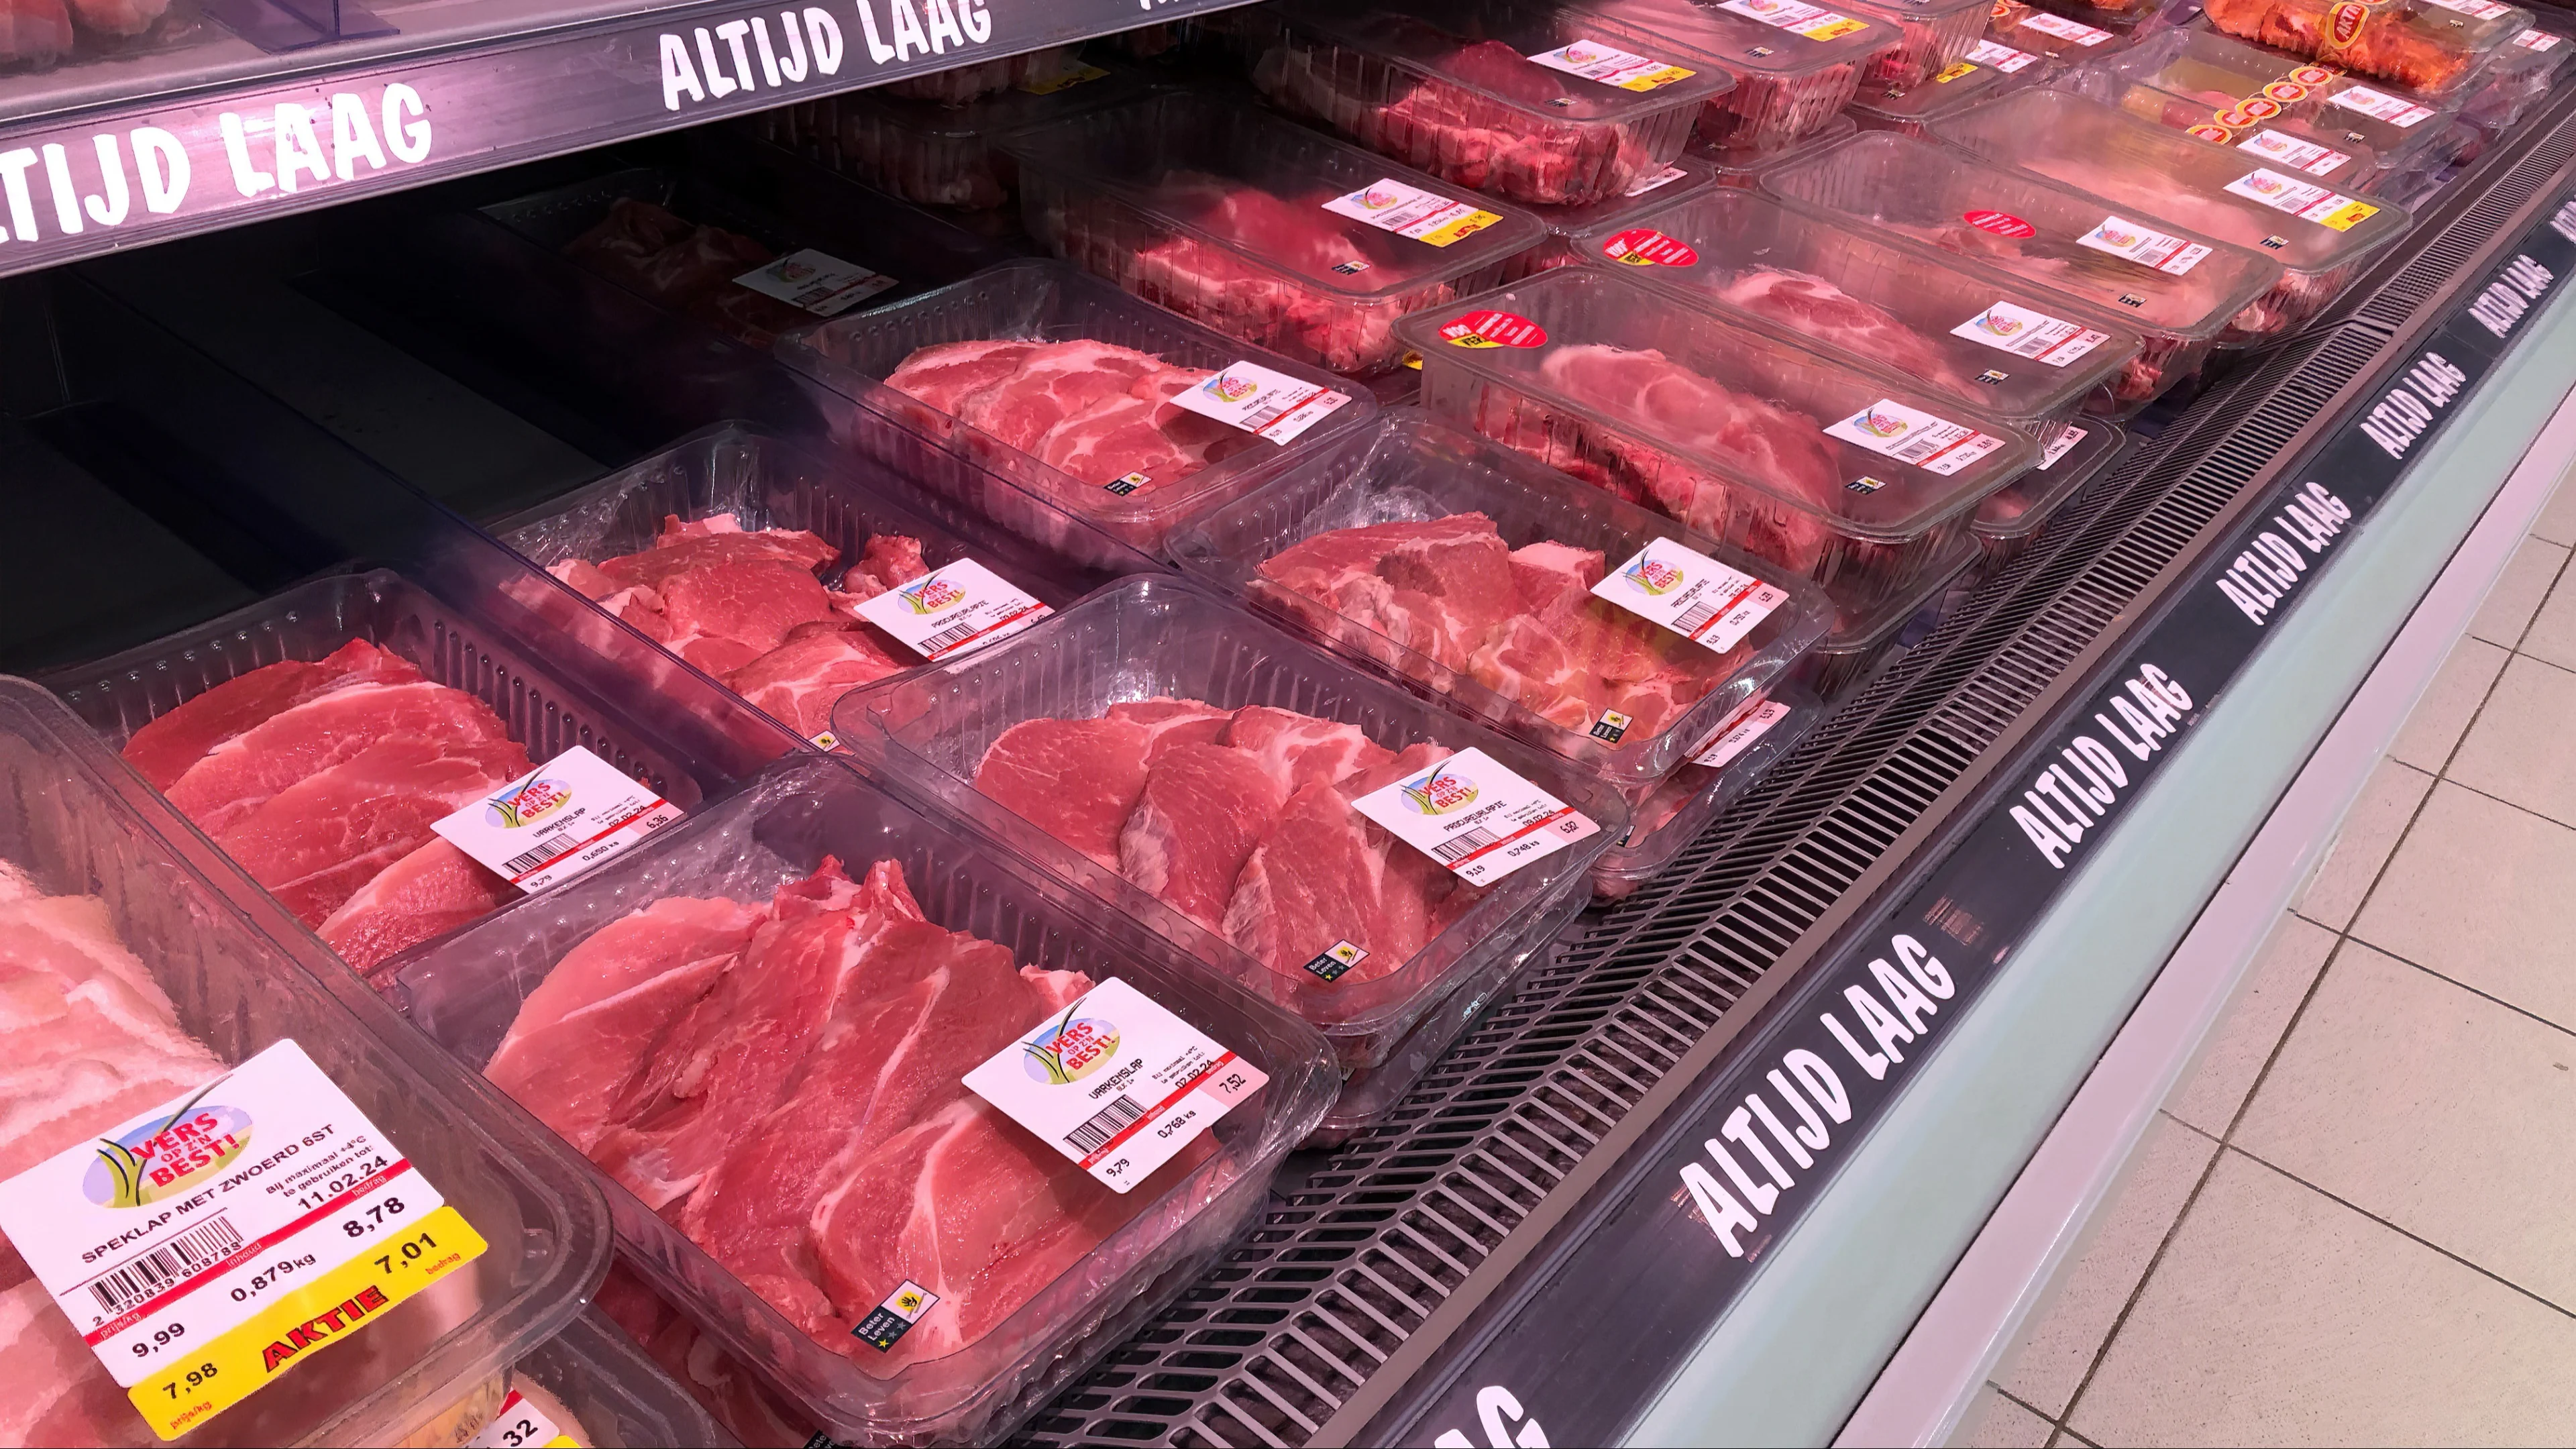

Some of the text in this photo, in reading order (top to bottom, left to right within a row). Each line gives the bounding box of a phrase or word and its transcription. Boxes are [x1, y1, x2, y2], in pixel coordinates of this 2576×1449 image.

[659, 0, 992, 111] ALTIJD LAAG
[0, 83, 433, 244] TIJD LAAG
[2468, 282, 2529, 338] ALTIJD
[2359, 352, 2466, 460] ALTIJD LAAG
[2216, 482, 2351, 626] ALTIJD LAAG
[914, 582, 948, 598] VERS
[2008, 663, 2193, 869] ALTIJD LAAG
[507, 783, 550, 806] VERS
[522, 792, 566, 818] BEST!
[1419, 777, 1456, 796] VERS
[1435, 787, 1474, 808] BEST!
[533, 808, 586, 838] VARKENSLAP
[1309, 957, 1327, 971] Beter
[1316, 961, 1336, 975] Leven
[1045, 1022, 1093, 1053] VERS
[1066, 1035, 1115, 1070] BEST!
[1068, 1046, 1079, 1055] OP
[1089, 1059, 1143, 1099] VARKENSLAP
[1219, 1073, 1246, 1093] 7,52
[1679, 934, 1955, 1258] ALTIJD LAAG
[130, 1113, 218, 1160] VERS
[161, 1148, 182, 1163] OP
[1106, 1110, 1196, 1177] 9,79 0,768 kg
[149, 1134, 239, 1187] BEST!
[266, 1181, 284, 1194] Bij
[285, 1152, 338, 1184] maximaal
[284, 1144, 374, 1197] te gebruiken tot:
[82, 1124, 334, 1263] SPEKLAP MET ZWOERD 6ST
[298, 1156, 388, 1210] 11.02.24
[343, 1197, 405, 1238] 8,78
[374, 1233, 437, 1275] 7,01
[93, 1316, 104, 1327] 2
[132, 1323, 185, 1358] 9,99
[262, 1285, 390, 1373] AKTIE
[859, 1313, 883, 1335] Beter
[867, 1317, 895, 1340] Leven
[162, 1362, 217, 1399] 7,98
